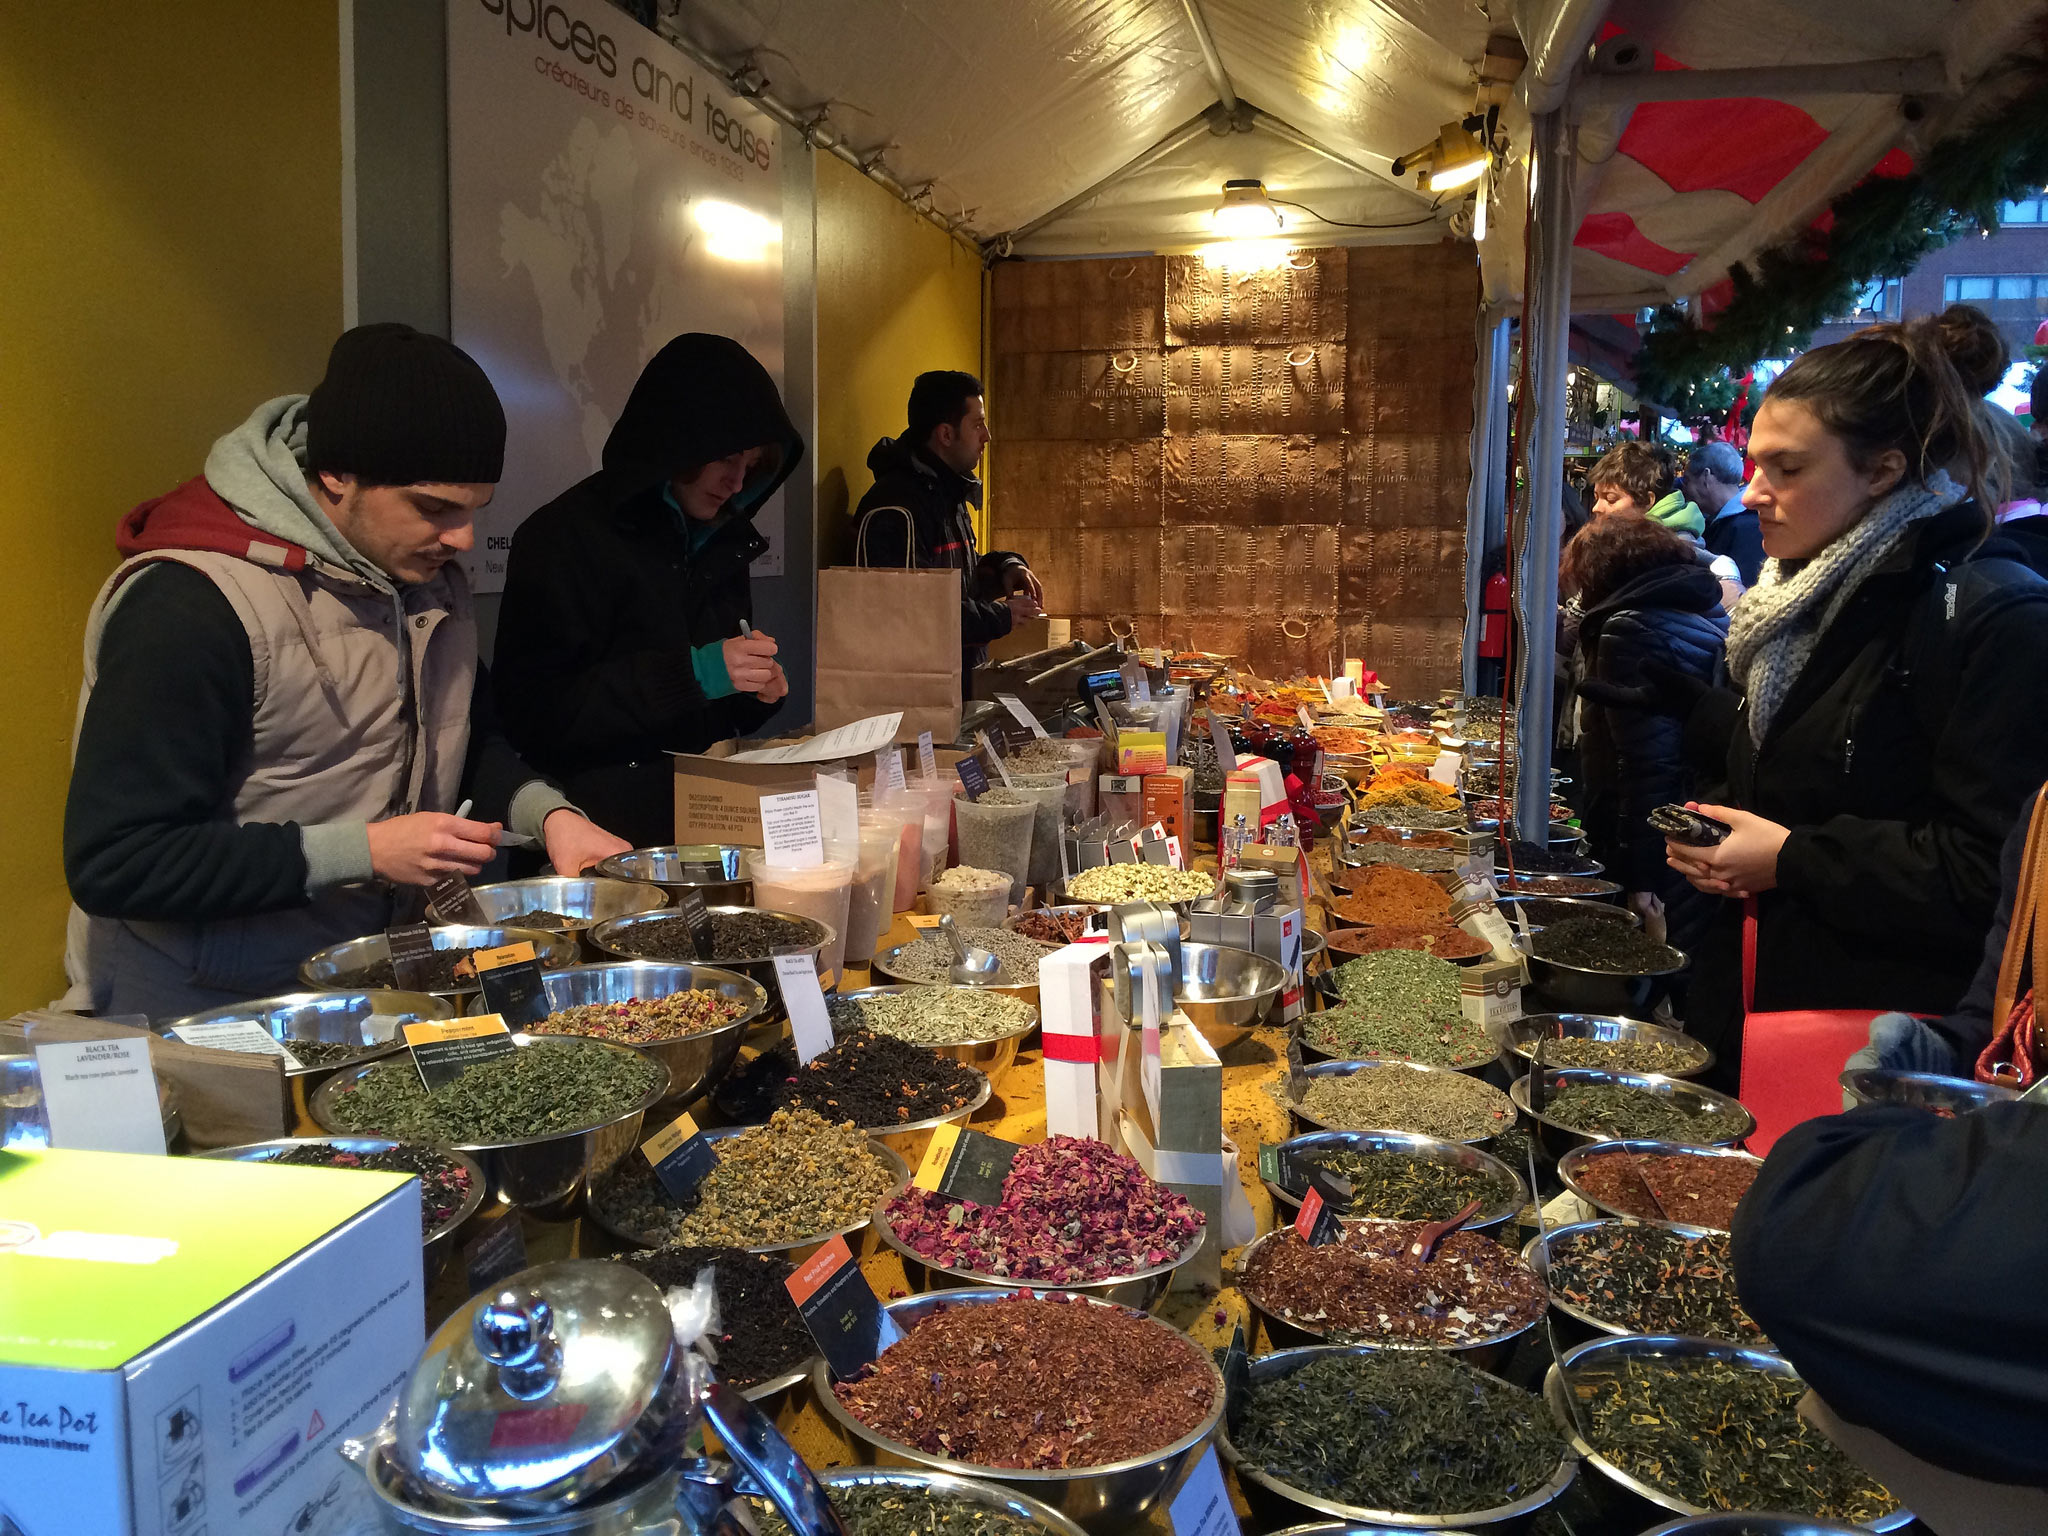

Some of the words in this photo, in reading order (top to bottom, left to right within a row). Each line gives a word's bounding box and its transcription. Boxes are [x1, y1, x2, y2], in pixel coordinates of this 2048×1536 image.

[535, 56, 610, 108] créateurs
[615, 97, 634, 120] de
[638, 112, 686, 149] saveurs
[632, 57, 693, 124] and
[704, 93, 769, 171] tease
[487, 536, 511, 550] CHEL
[440, 1025, 475, 1034] Peppermint
[77, 1052, 130, 1062] LAVENDER/ROSE
[417, 1047, 444, 1056] Peppermint
[16, 1402, 52, 1428] Tea
[59, 1405, 98, 1435] Pot
[238, 1501, 254, 1519] This
[254, 1470, 288, 1506] product
[296, 1452, 309, 1468] not
[310, 1418, 351, 1458] microwave
[352, 1411, 360, 1420] or
[380, 1383, 391, 1398] top
